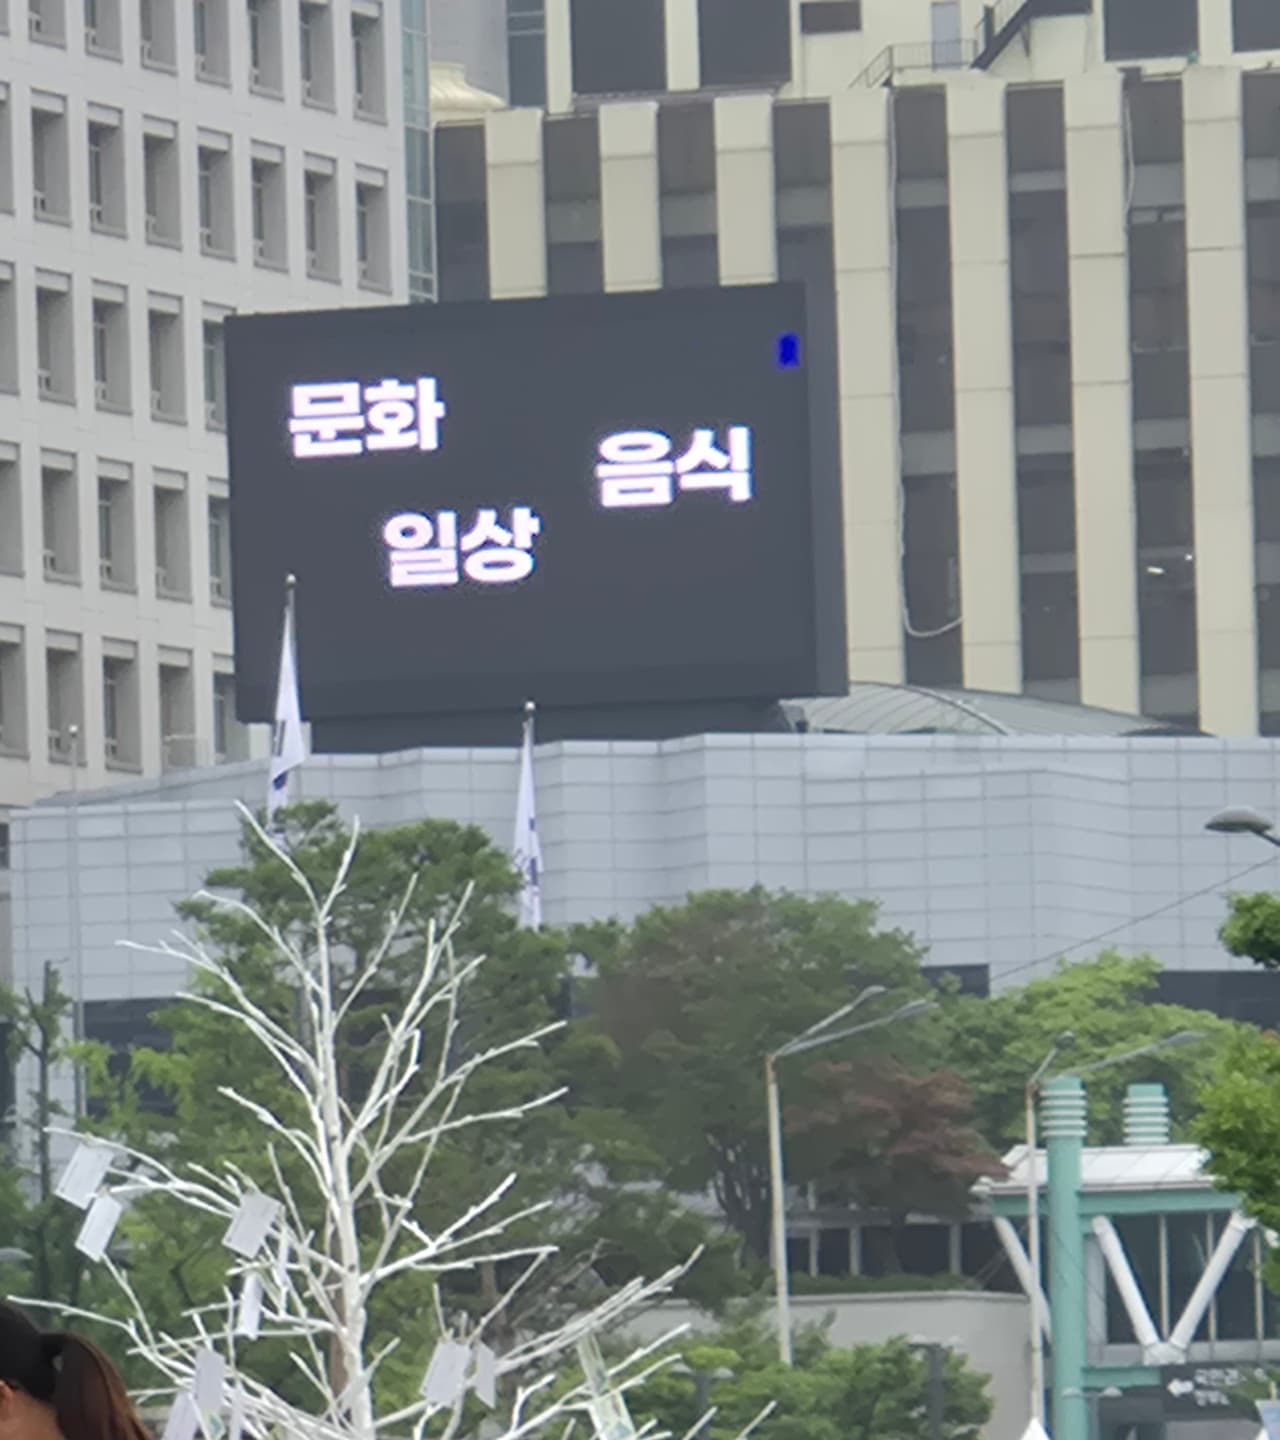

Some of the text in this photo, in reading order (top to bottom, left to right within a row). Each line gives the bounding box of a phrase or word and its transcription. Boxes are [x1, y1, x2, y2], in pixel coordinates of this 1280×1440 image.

[289, 377, 445, 458] 문화
[595, 426, 752, 507] 음식
[383, 507, 540, 587] 일상
